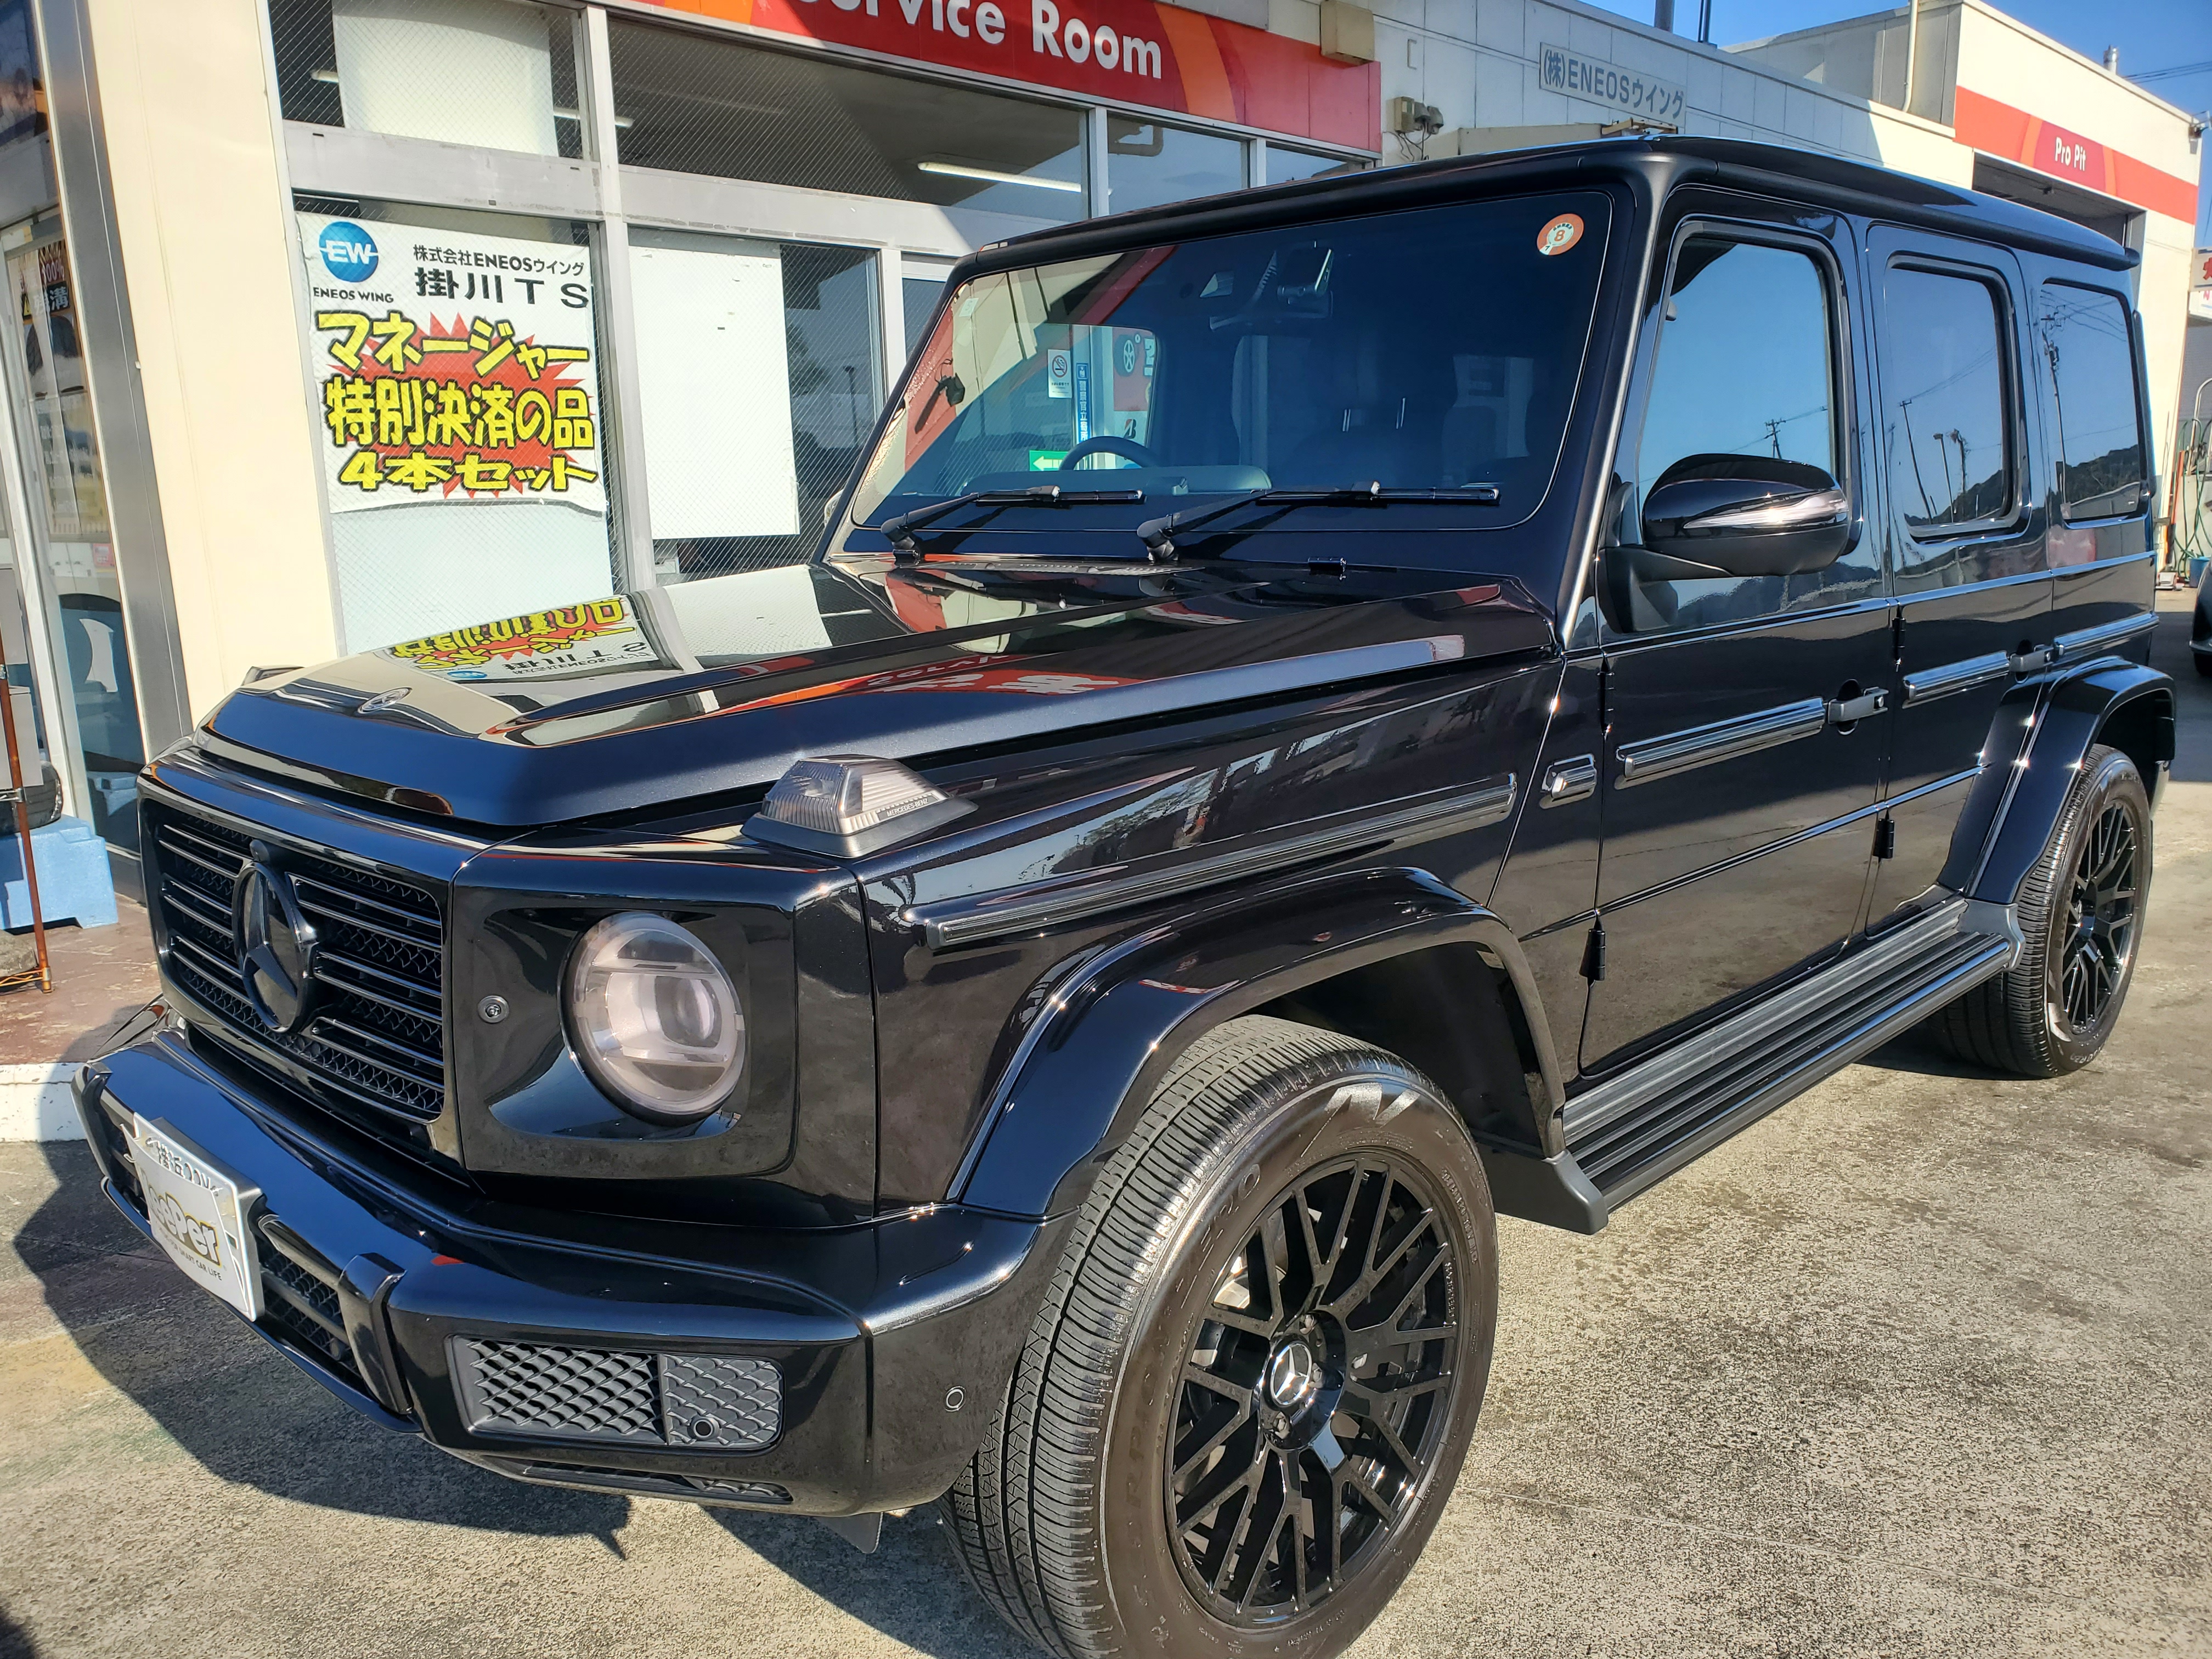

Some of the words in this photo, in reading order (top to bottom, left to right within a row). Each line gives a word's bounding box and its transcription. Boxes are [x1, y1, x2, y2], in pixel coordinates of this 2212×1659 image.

[798, 0, 1006, 44] vice
[1032, 0, 1162, 79] Room
[2055, 137, 2071, 166] Pro
[2074, 143, 2086, 172] Pit
[1554, 229, 1565, 241] 8
[327, 240, 371, 265] EW
[313, 287, 356, 301] ENEOS
[358, 290, 394, 303] WING
[315, 310, 590, 380] マネージャー
[325, 376, 594, 449] 特別決済の品
[339, 451, 599, 492] 4本セット
[887, 798, 929, 817] MERCEDES-BENZ
[196, 1260, 207, 1273] CAR
[207, 1267, 222, 1281] LIFE
